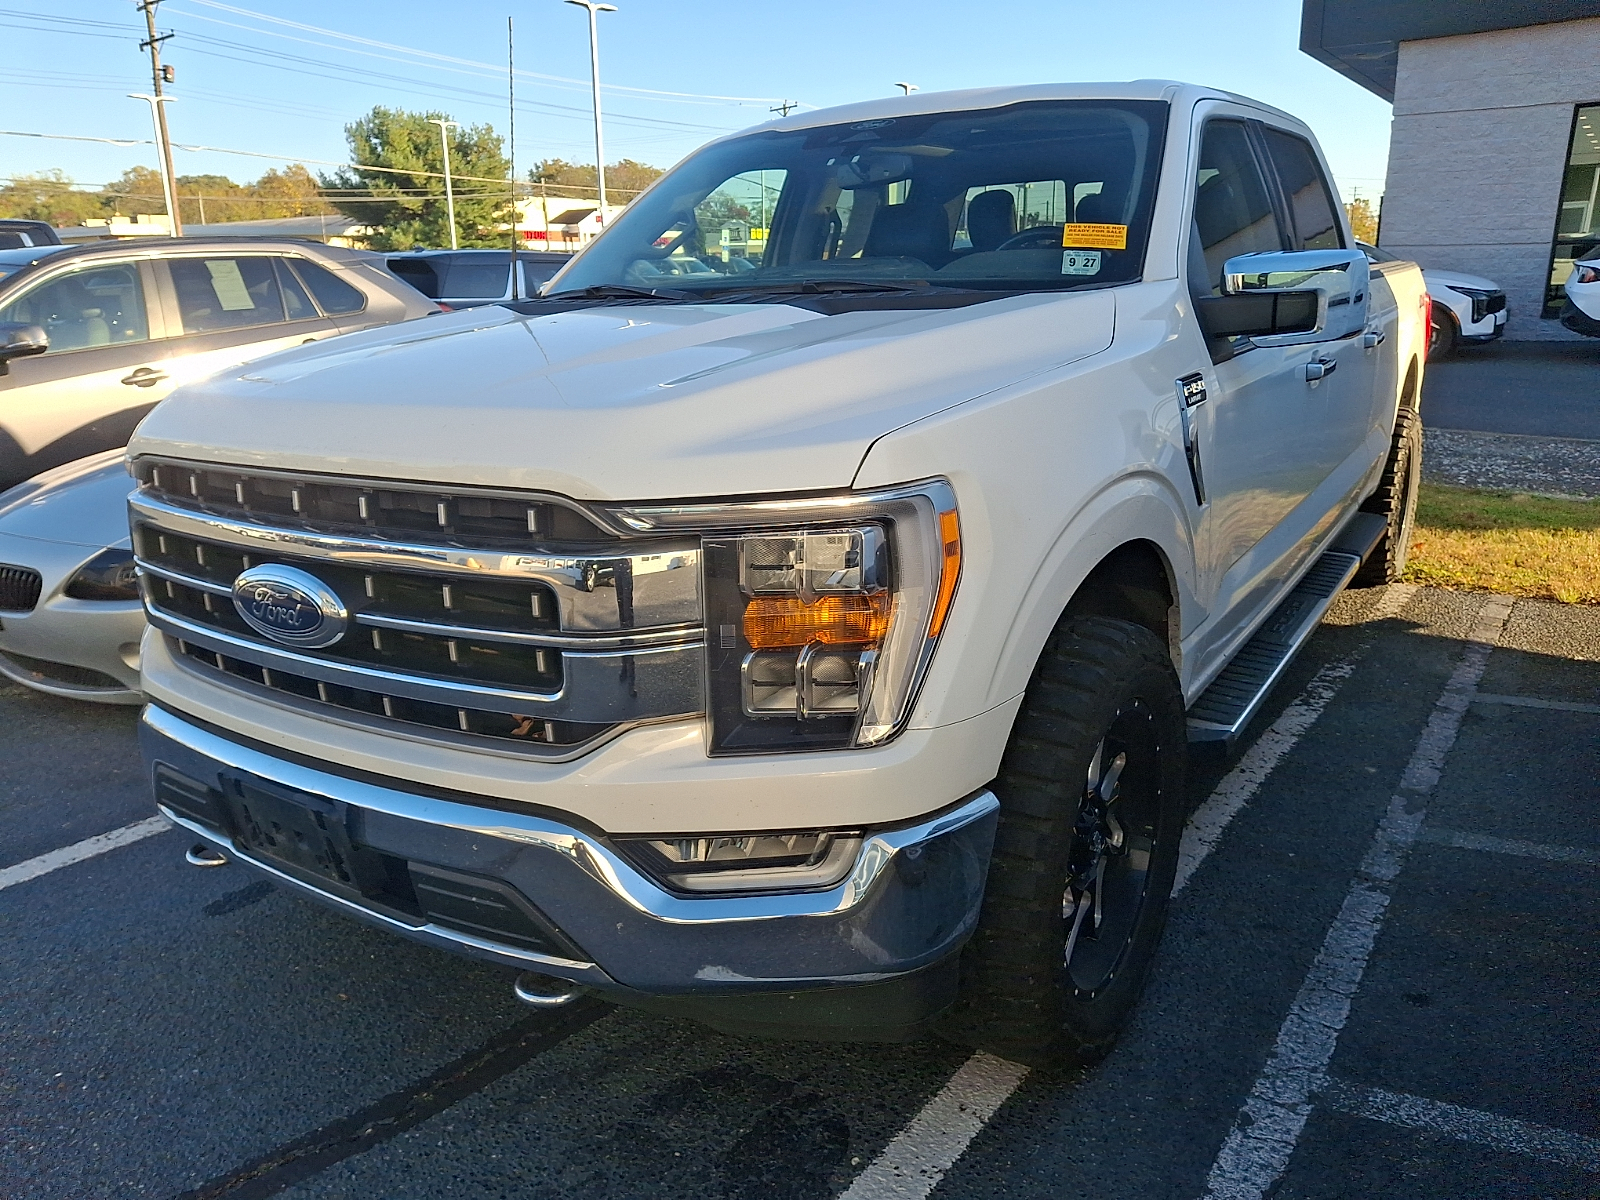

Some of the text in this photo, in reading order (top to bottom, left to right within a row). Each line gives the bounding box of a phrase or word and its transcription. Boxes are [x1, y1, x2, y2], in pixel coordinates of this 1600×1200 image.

[1069, 257, 1097, 268] 9 27
[252, 587, 303, 626] Ford
